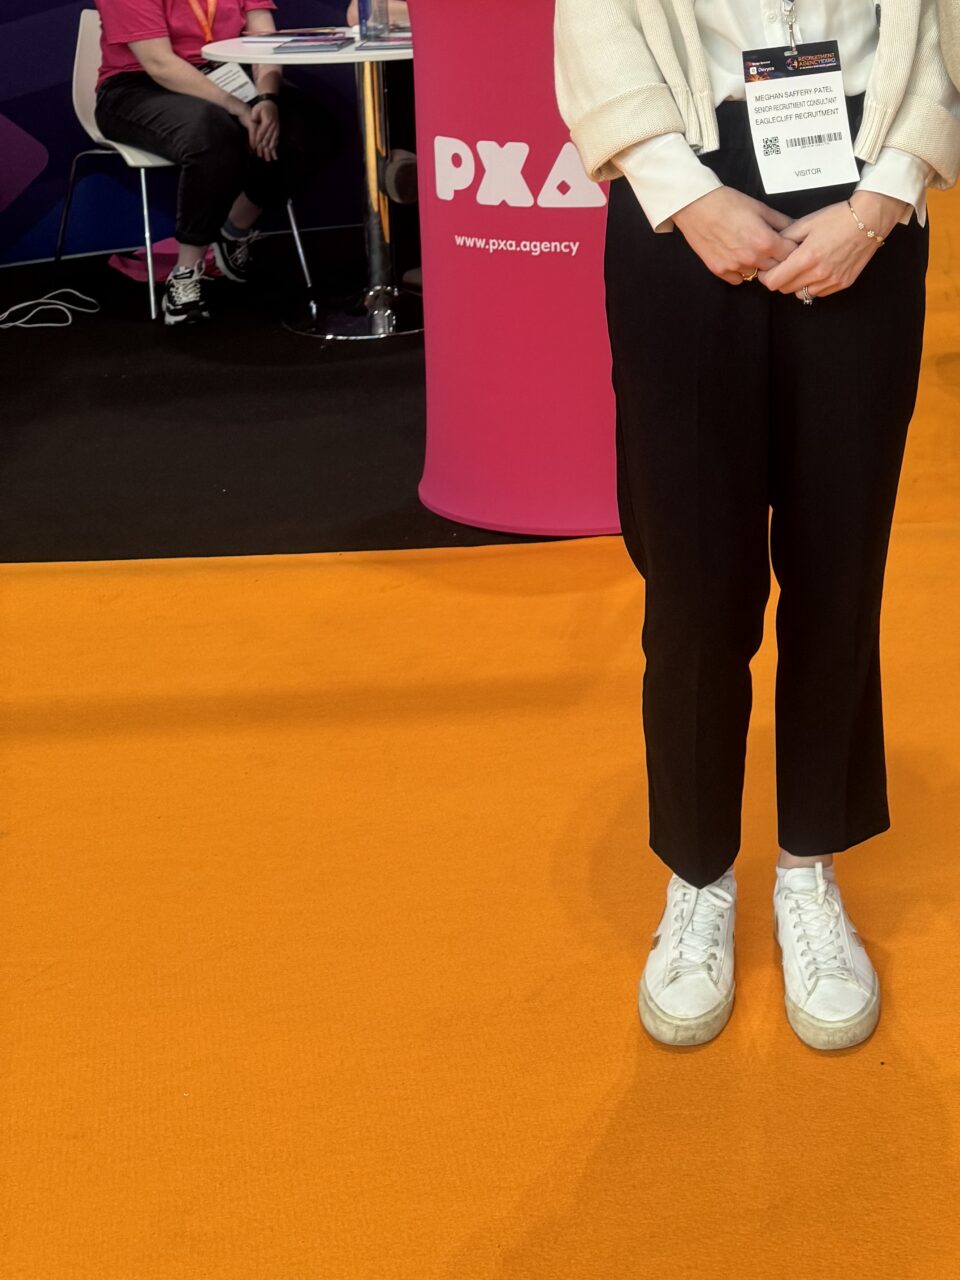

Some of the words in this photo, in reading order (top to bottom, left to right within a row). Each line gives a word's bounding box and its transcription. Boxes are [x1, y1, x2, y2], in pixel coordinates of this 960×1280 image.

[754, 92, 783, 102] MEGHAN
[784, 88, 813, 99] SAFFERY
[814, 85, 833, 94] PATEL
[754, 105, 773, 114] SENIOR
[773, 100, 806, 111] RECRUITMENT
[806, 96, 838, 107] CONSULTANT
[755, 113, 793, 126] EAGLECLIFF
[794, 107, 839, 120] RECRUITMENT
[433, 135, 607, 209] PXA
[794, 167, 822, 177] VISITOR
[454, 234, 580, 257] www.pxa.agency
